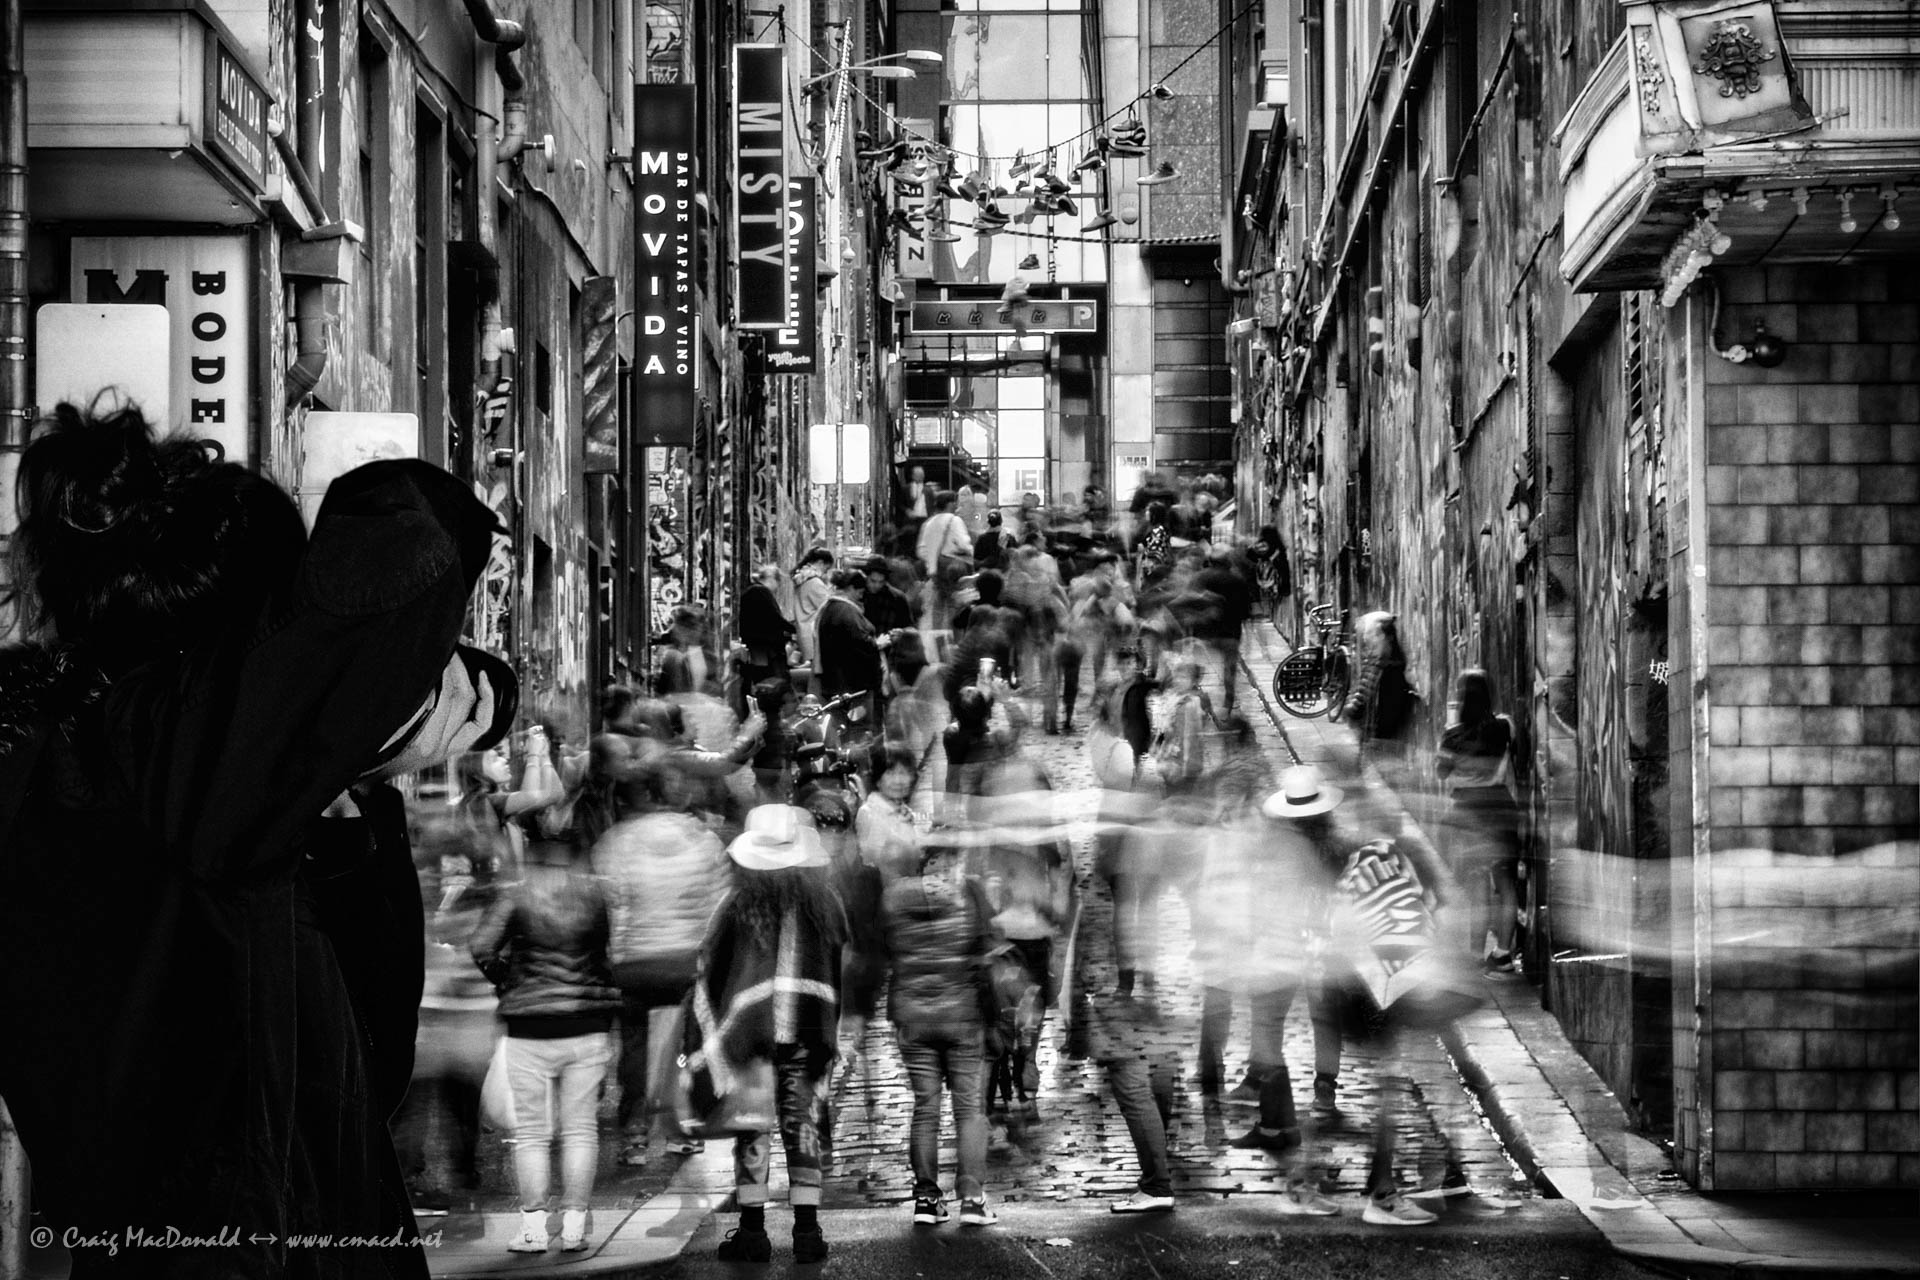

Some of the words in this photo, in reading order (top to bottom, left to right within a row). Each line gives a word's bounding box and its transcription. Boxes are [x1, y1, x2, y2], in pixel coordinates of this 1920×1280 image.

[221, 56, 261, 135] MOVIDA
[676, 152, 688, 188] BAR
[739, 103, 783, 266] MISTY
[676, 200, 688, 222] DE
[641, 151, 669, 375] MOVIDA
[676, 233, 688, 293] TAPAS
[676, 304, 688, 314] Y
[1073, 305, 1093, 326] P
[676, 325, 688, 375] VINO
